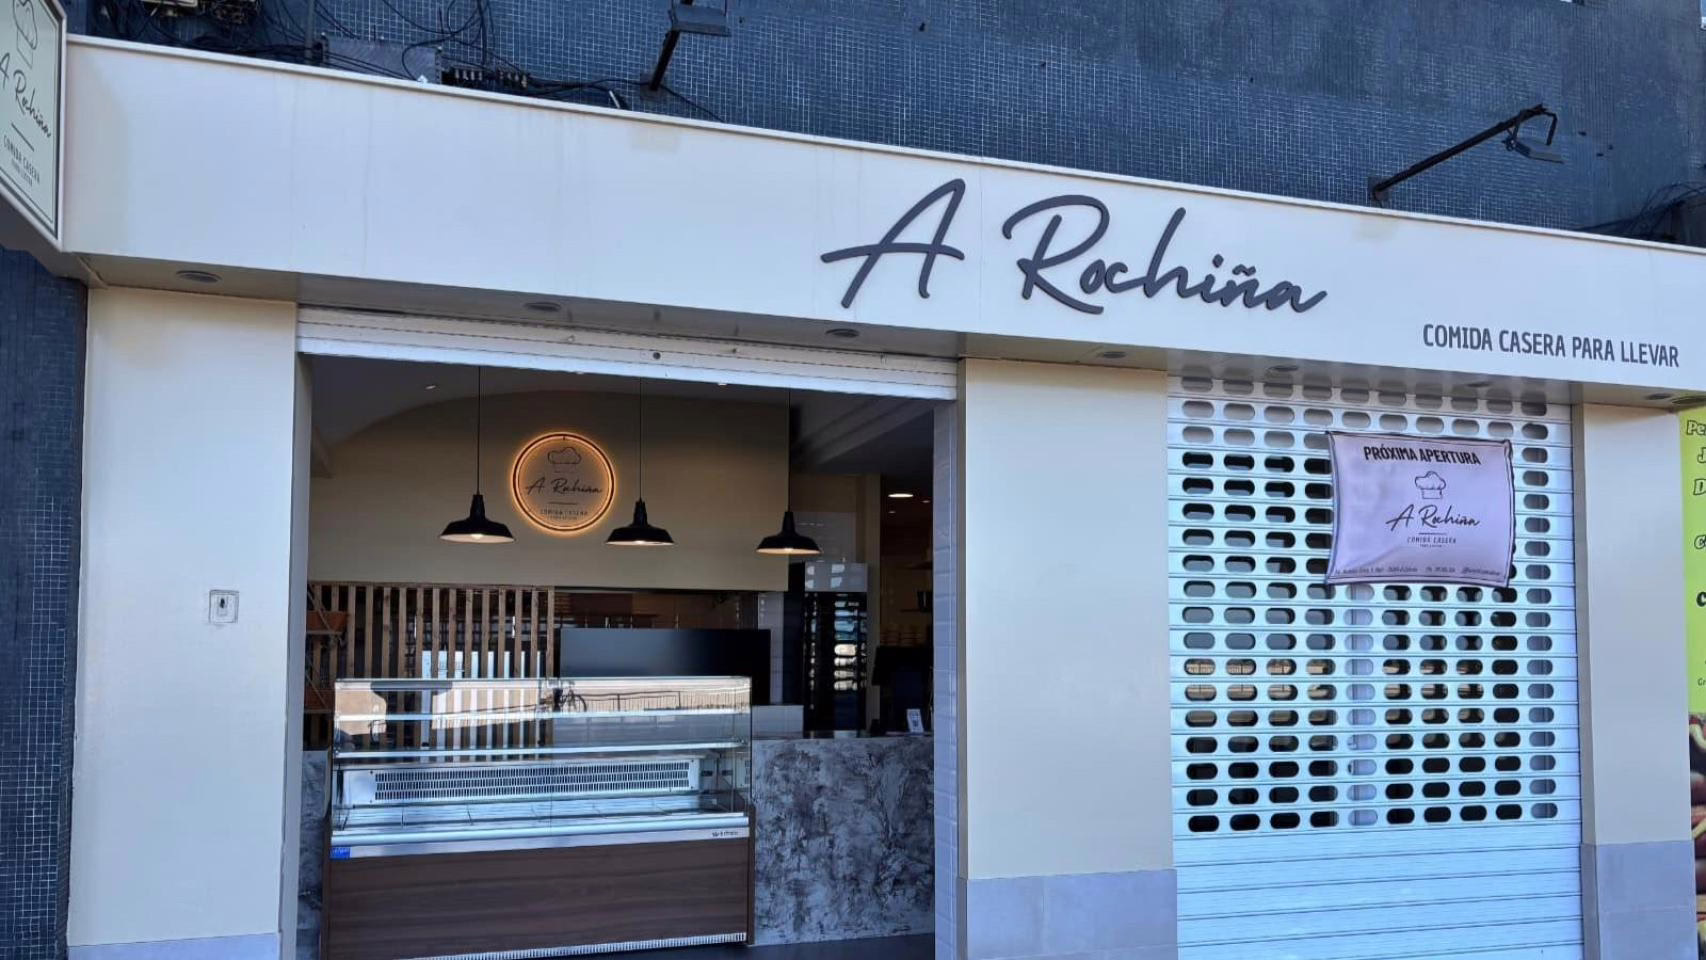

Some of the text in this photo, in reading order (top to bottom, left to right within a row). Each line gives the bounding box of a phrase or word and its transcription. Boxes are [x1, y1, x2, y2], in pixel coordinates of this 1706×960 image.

[820, 178, 1328, 315] A Rochiña
[1423, 324, 1679, 367] COMIDA CASERA PARA LLEVAR
[1363, 444, 1482, 465] PRÓXIMA APERTURA
[1385, 504, 1414, 531] A
